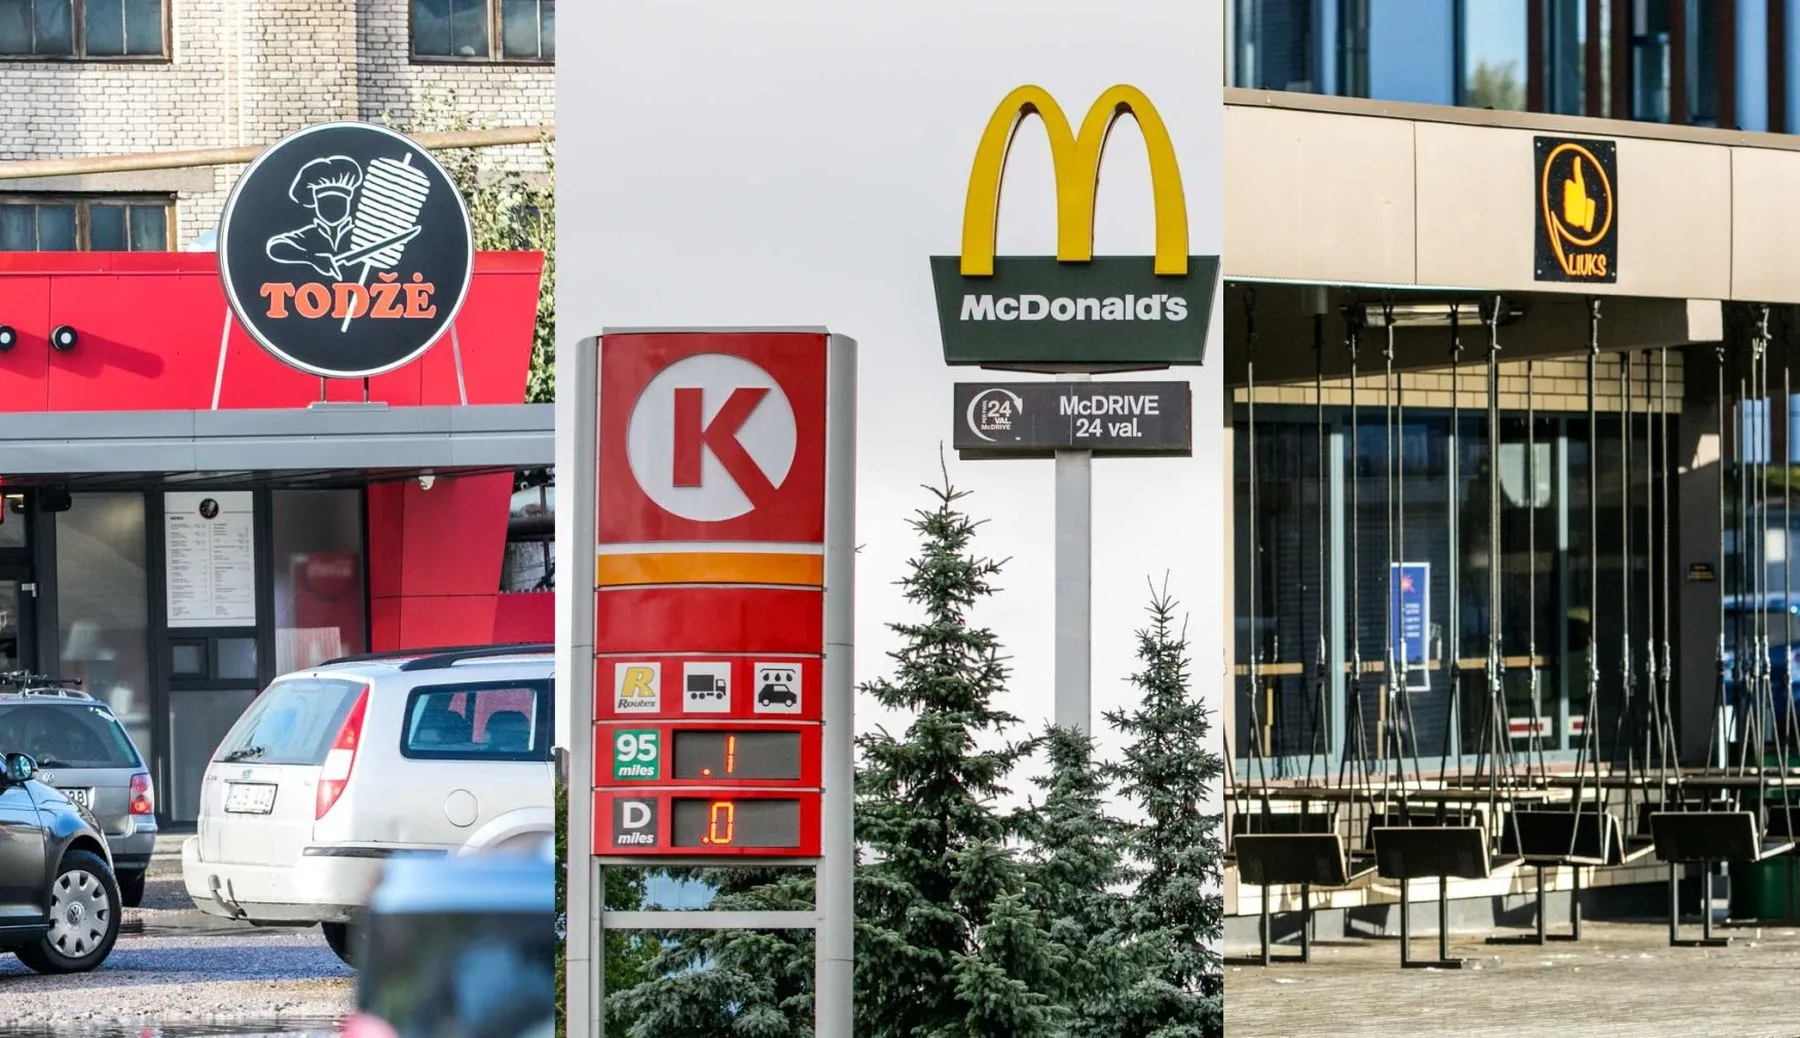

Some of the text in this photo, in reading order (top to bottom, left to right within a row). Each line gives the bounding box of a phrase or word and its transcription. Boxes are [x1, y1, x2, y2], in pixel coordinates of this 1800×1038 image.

[1568, 253, 1607, 277] LIUKS
[259, 271, 437, 319] TODŽĖ
[959, 294, 1188, 322] McDonald's
[987, 400, 1012, 418] 24
[1059, 395, 1160, 416] McDRIVE
[1075, 417, 1142, 438] 24 val.
[671, 386, 784, 510] K
[616, 733, 658, 762] 95
[618, 764, 655, 776] miles
[622, 801, 652, 829] D
[617, 833, 654, 844] miles
